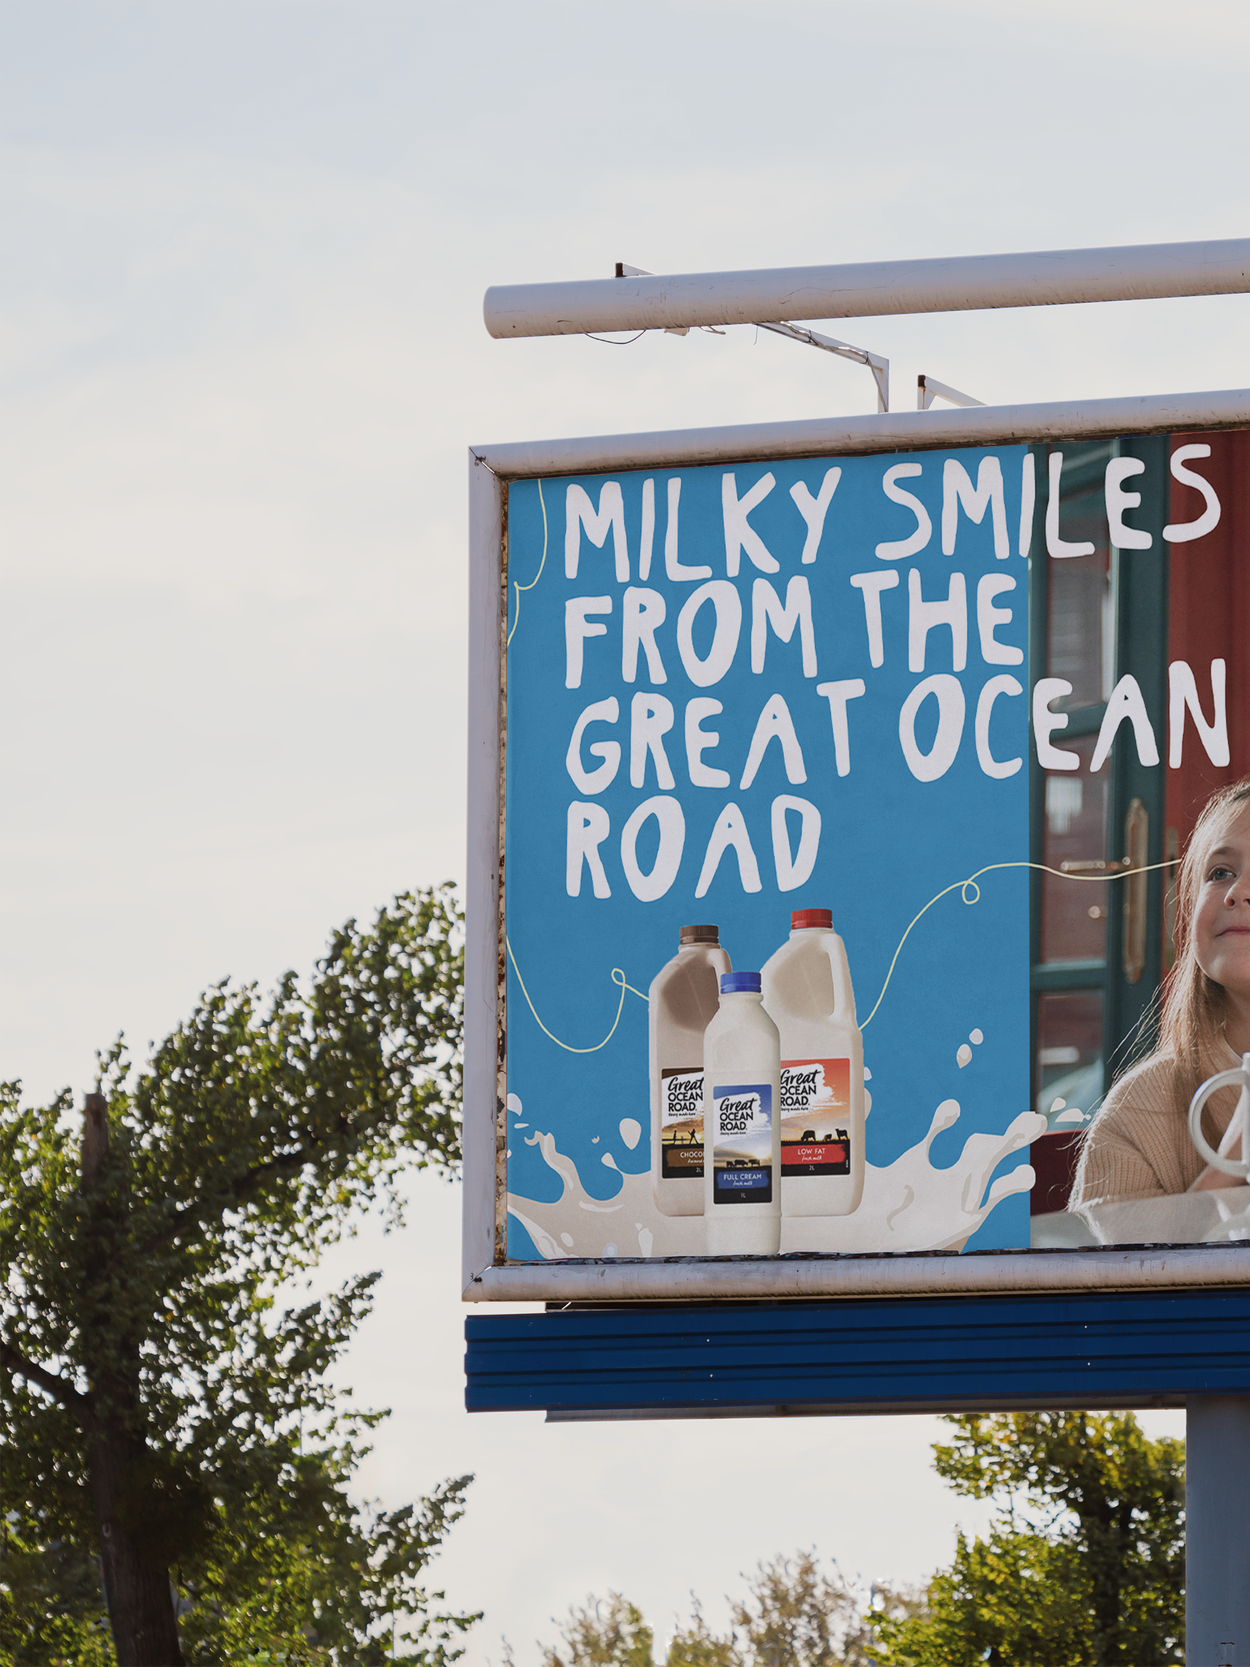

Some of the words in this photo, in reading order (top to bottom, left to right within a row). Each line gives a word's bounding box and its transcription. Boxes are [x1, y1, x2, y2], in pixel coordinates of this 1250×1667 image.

[565, 466, 842, 582] MILKY
[874, 443, 1221, 560] SMILES
[564, 575, 818, 689] FROM
[850, 569, 1024, 673] THE
[565, 678, 866, 796] GREAT
[899, 658, 1230, 782] OCEAN
[566, 795, 822, 902] ROAD
[668, 1077, 704, 1092] Great
[780, 1069, 822, 1086] Great
[668, 1092, 704, 1102] OCEAN
[780, 1085, 817, 1096] OCEAN
[719, 1097, 758, 1113] Great
[720, 1112, 754, 1122] OCEAN
[723, 1173, 738, 1181] FULL
